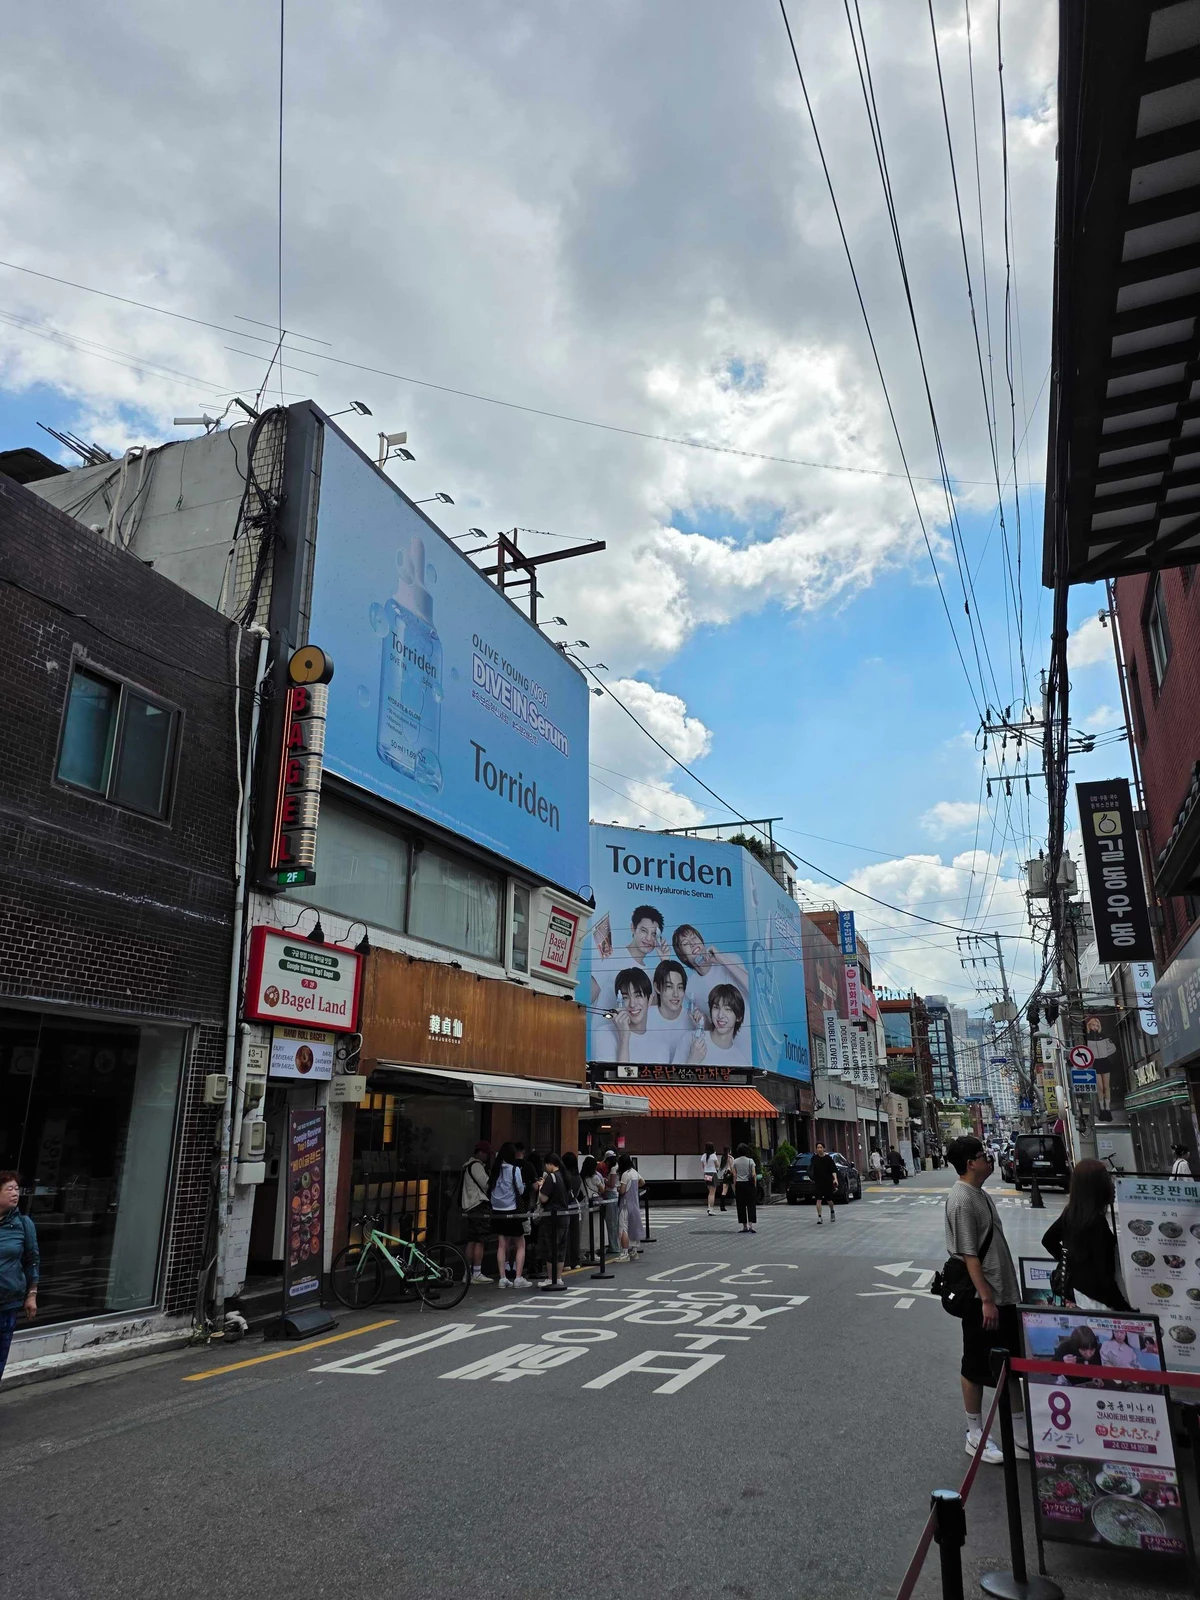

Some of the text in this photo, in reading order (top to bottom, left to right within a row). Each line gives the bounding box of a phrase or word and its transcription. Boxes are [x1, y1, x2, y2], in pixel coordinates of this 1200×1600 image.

[391, 631, 437, 679] Torriden
[472, 633, 499, 665] OLIVE
[501, 658, 529, 691] YOUNG
[472, 652, 512, 711] DIVE
[512, 686, 528, 723] IN
[528, 701, 569, 759] Serum
[278, 686, 307, 863] BAGEL
[469, 739, 560, 833] Torriden
[606, 844, 732, 888] Torriden
[286, 872, 298, 884] 2F
[627, 882, 714, 900] DIVE IN Hyaluronic Serum
[1097, 838, 1137, 947] 길동우동
[549, 932, 568, 951] Bagel
[547, 947, 565, 963] Land
[286, 962, 300, 971] Google
[300, 966, 314, 974] Review
[323, 970, 334, 979] Bagel
[281, 989, 315, 1012] Bagel
[318, 997, 347, 1016] Land
[848, 982, 859, 1016] 만화카페
[297, 1029, 309, 1040] ROLL
[827, 1017, 838, 1070] DOUBLE LOVERS
[840, 1025, 848, 1050] DOUBLE
[783, 1033, 809, 1066] Torriden
[640, 1065, 732, 1082] 소문난 성수 감자탕
[852, 1056, 860, 1079] LOVERS
[1073, 1084, 1097, 1092] 일방통행
[293, 1126, 322, 1145] Google Review
[306, 1136, 318, 1148] Bagel
[1136, 1183, 1199, 1198] 포장판매
[1047, 1390, 1072, 1431] 8
[1107, 1400, 1154, 1414] 능동미나리
[1042, 1427, 1085, 1445] カンテレ
